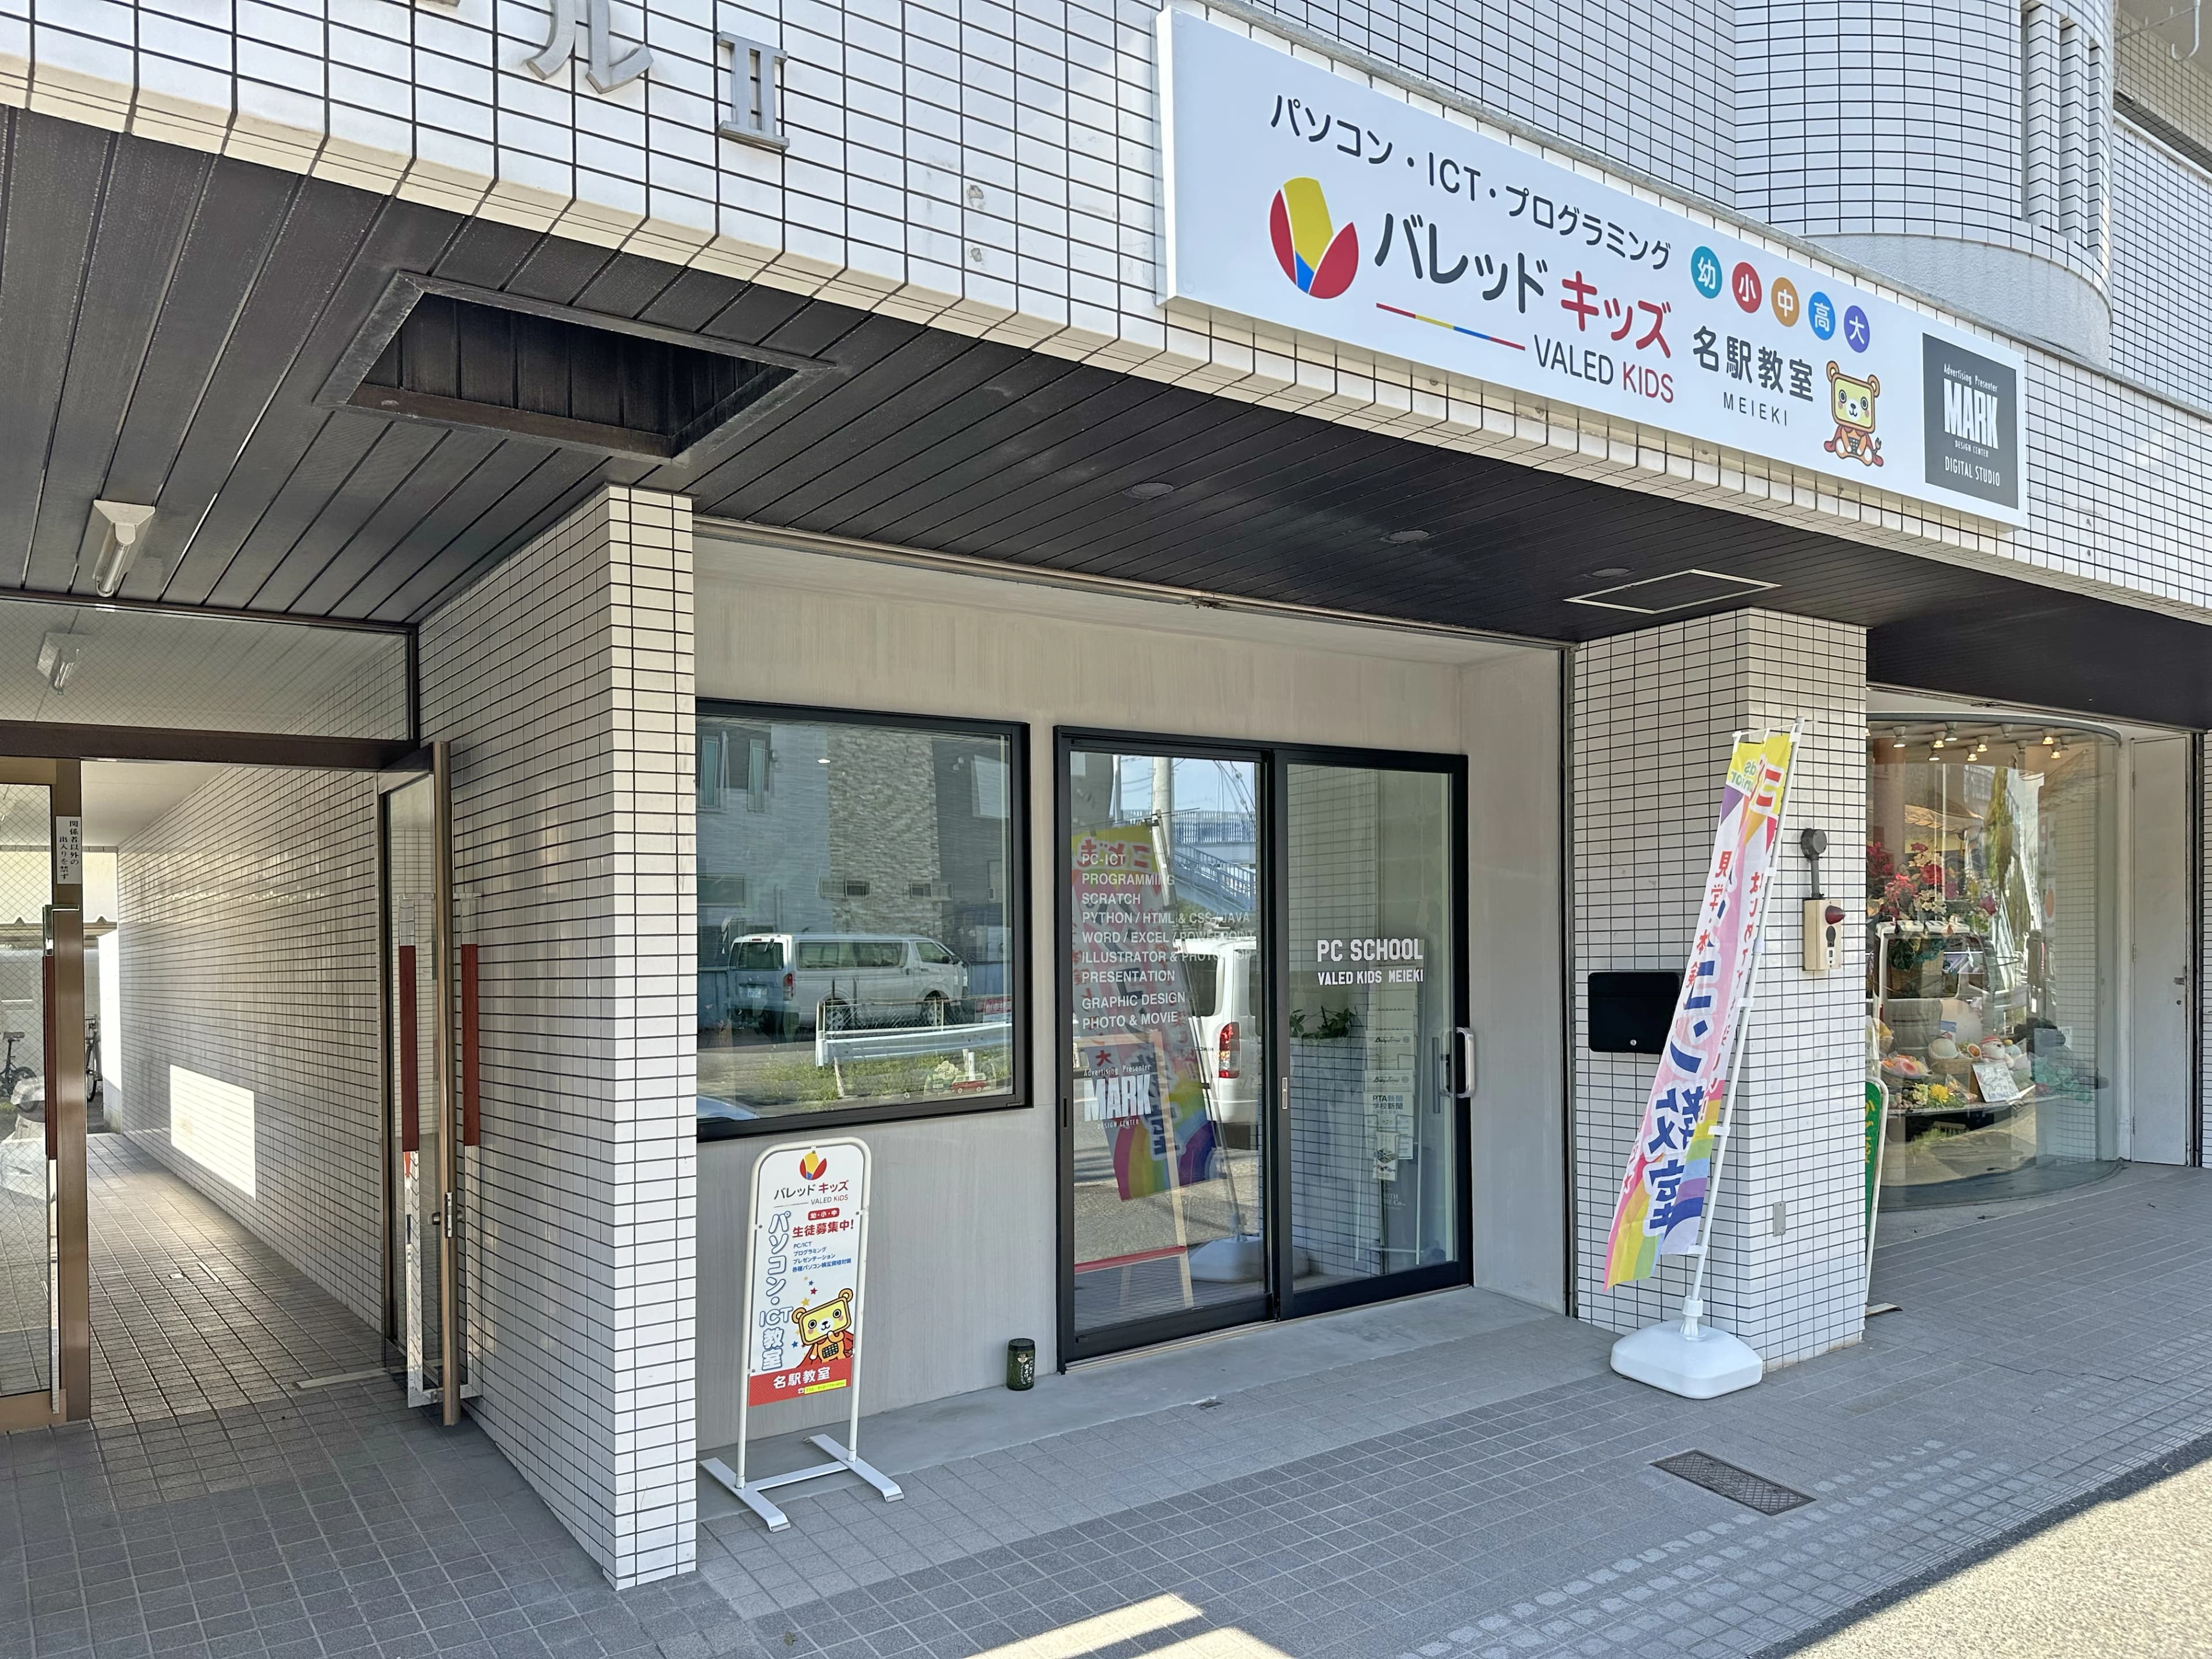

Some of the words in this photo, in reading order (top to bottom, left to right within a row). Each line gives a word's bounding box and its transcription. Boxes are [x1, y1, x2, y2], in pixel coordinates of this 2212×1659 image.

[1271, 94, 1671, 270] パソコン・ICT・プログラミング
[1375, 213, 1548, 314] バレッド
[1560, 271, 1672, 358] キッズ
[1533, 334, 1613, 385] VALED
[1622, 362, 1673, 403] KIDS
[1693, 325, 1814, 403] 名駅教室
[1944, 363, 1972, 385] Advertising
[1975, 375, 1998, 393] Presenter
[1724, 392, 1787, 426] MEIEKI
[1944, 378, 1999, 449] MARK
[1955, 440, 1971, 453] DESIGN
[1973, 446, 1988, 458] CENTER
[1945, 456, 1973, 479] DIGITAL
[1975, 465, 2000, 487] STUDIO
[69, 820, 79, 865] 関係者以外の
[1082, 854, 1126, 865] PC-ICT
[1081, 893, 1141, 905] SCRATCH
[1082, 912, 1134, 924] PYTHON
[1143, 912, 1175, 923] HTML
[1222, 912, 1250, 923] JAVA
[1082, 931, 1121, 944] WORD
[1130, 931, 1170, 943] EXCEL
[1081, 951, 1166, 964] ILLUSTRATOR
[1169, 951, 1178, 963] &
[1317, 939, 1343, 963] PC
[1350, 938, 1423, 961] SCHOOL
[1082, 970, 1176, 983] PRESENTATION
[1317, 971, 1354, 986] VALED
[1357, 970, 1382, 984] KIDS
[1388, 969, 1423, 983] MEIEKI
[1082, 994, 1139, 1010] GRAPHIC
[1142, 991, 1186, 1006] DESIGN
[1082, 1015, 1126, 1029] PHOTO
[1129, 1014, 1138, 1026] &
[1141, 1012, 1179, 1025] MOVIE
[1084, 1066, 1119, 1077] Advertising
[1122, 1065, 1152, 1073] Presenter
[1084, 1074, 1152, 1122] MARK
[774, 1184, 816, 1200] バレッド
[819, 1180, 849, 1194] キッズ
[811, 1196, 832, 1205] VALED
[834, 1194, 849, 1202] KIDS
[792, 1219, 854, 1238] 生徒募集中!
[793, 1247, 827, 1257] プログラミング
[773, 1366, 831, 1389] 名駅教室
